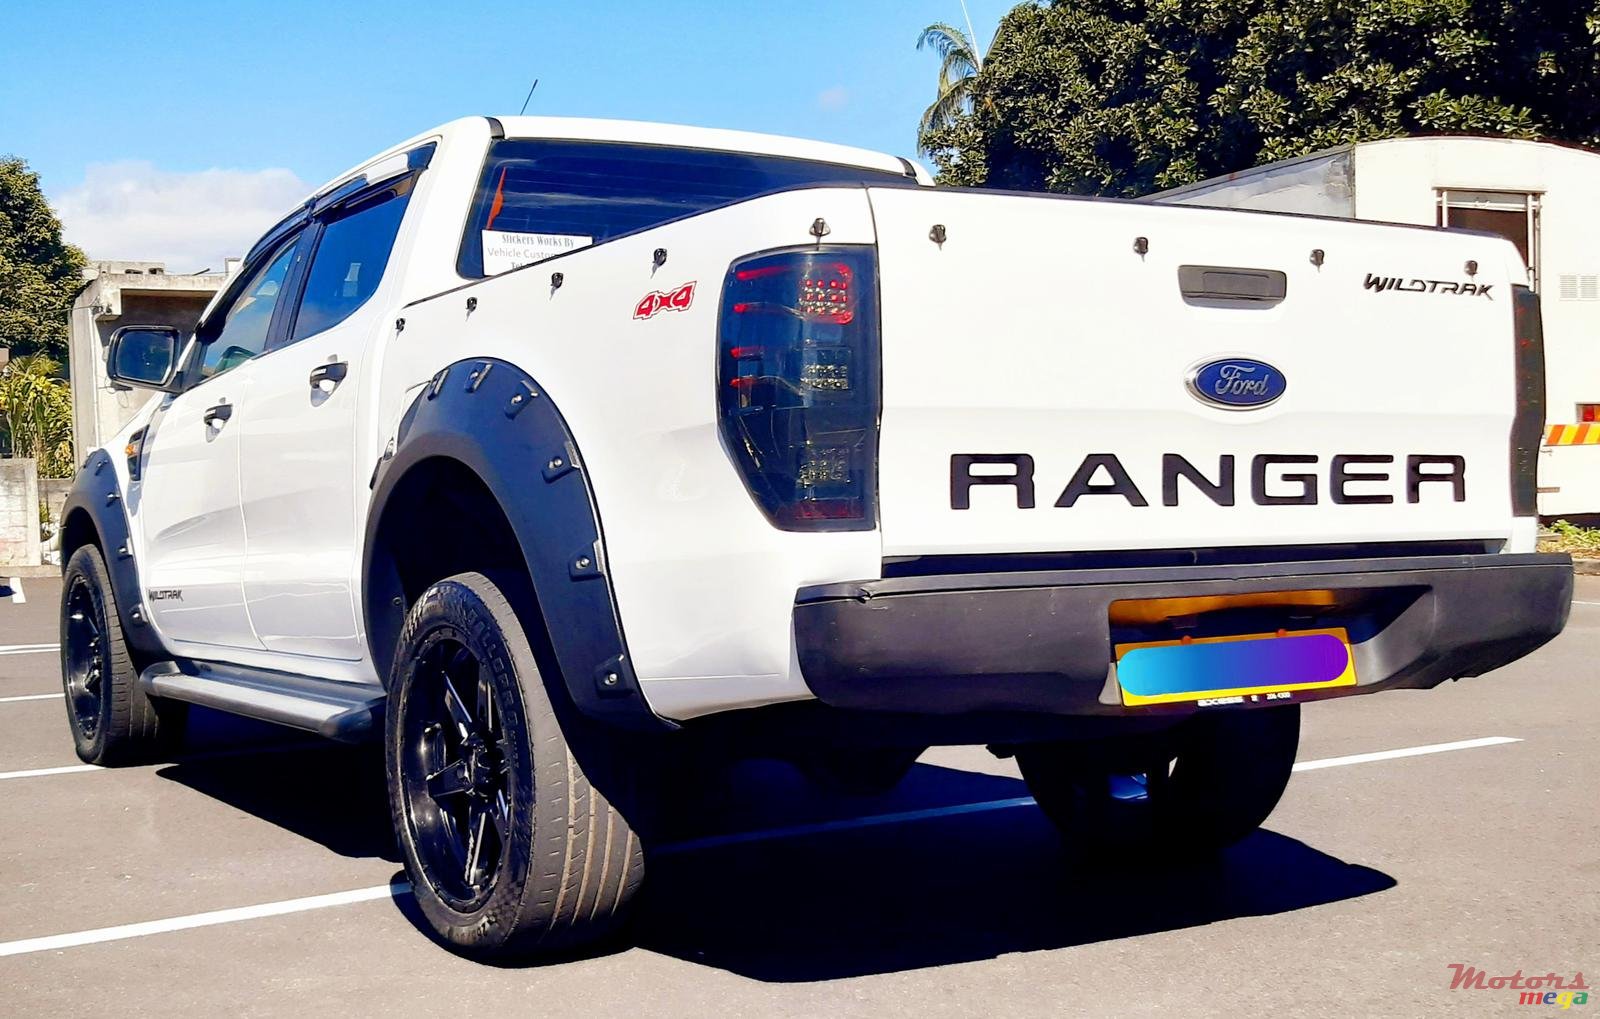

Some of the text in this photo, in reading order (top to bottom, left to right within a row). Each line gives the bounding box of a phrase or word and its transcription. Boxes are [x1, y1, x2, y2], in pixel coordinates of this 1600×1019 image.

[487, 247, 521, 258] Vehicle
[502, 234, 574, 248] Stickers Works By
[1363, 273, 1496, 301] WILDTRAK
[1214, 364, 1270, 397] Ford
[950, 453, 1465, 510] RANGER
